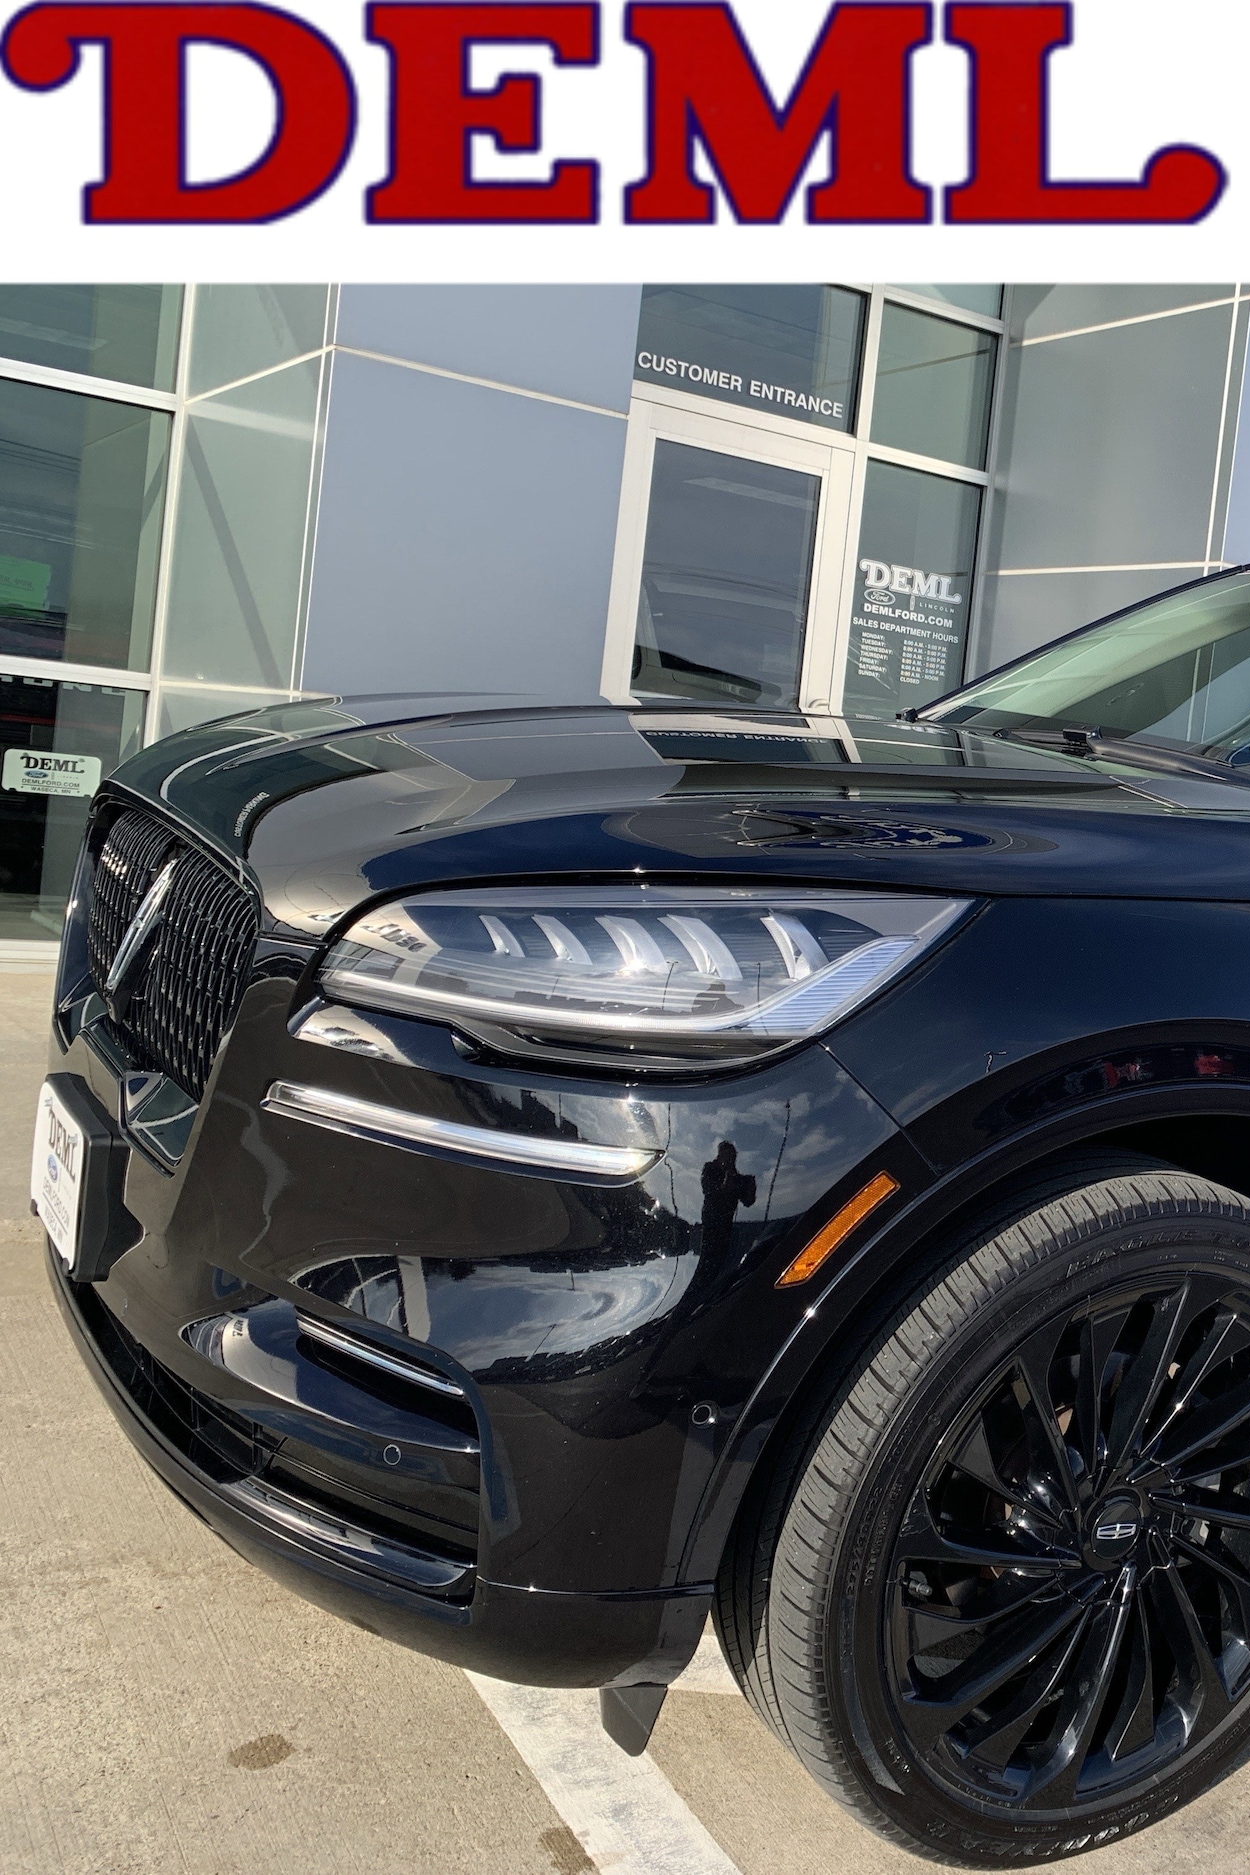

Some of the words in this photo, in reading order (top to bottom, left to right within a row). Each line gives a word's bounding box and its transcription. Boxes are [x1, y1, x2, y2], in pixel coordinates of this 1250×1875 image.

[638, 351, 743, 392] CUSTOMER
[750, 380, 844, 419] ENTRANCE
[859, 558, 962, 604] DEML
[864, 603, 953, 628] DEMLFORD.COM
[920, 602, 955, 613] LINCOLN
[852, 617, 879, 629] SALES
[880, 622, 931, 638] DEPARTMENT
[932, 634, 959, 644] HOURS
[900, 676, 920, 685] CLOSED
[20, 756, 85, 774] DEML
[22, 778, 79, 787] DEMLFORD.COM
[48, 1110, 76, 1184] DEML
